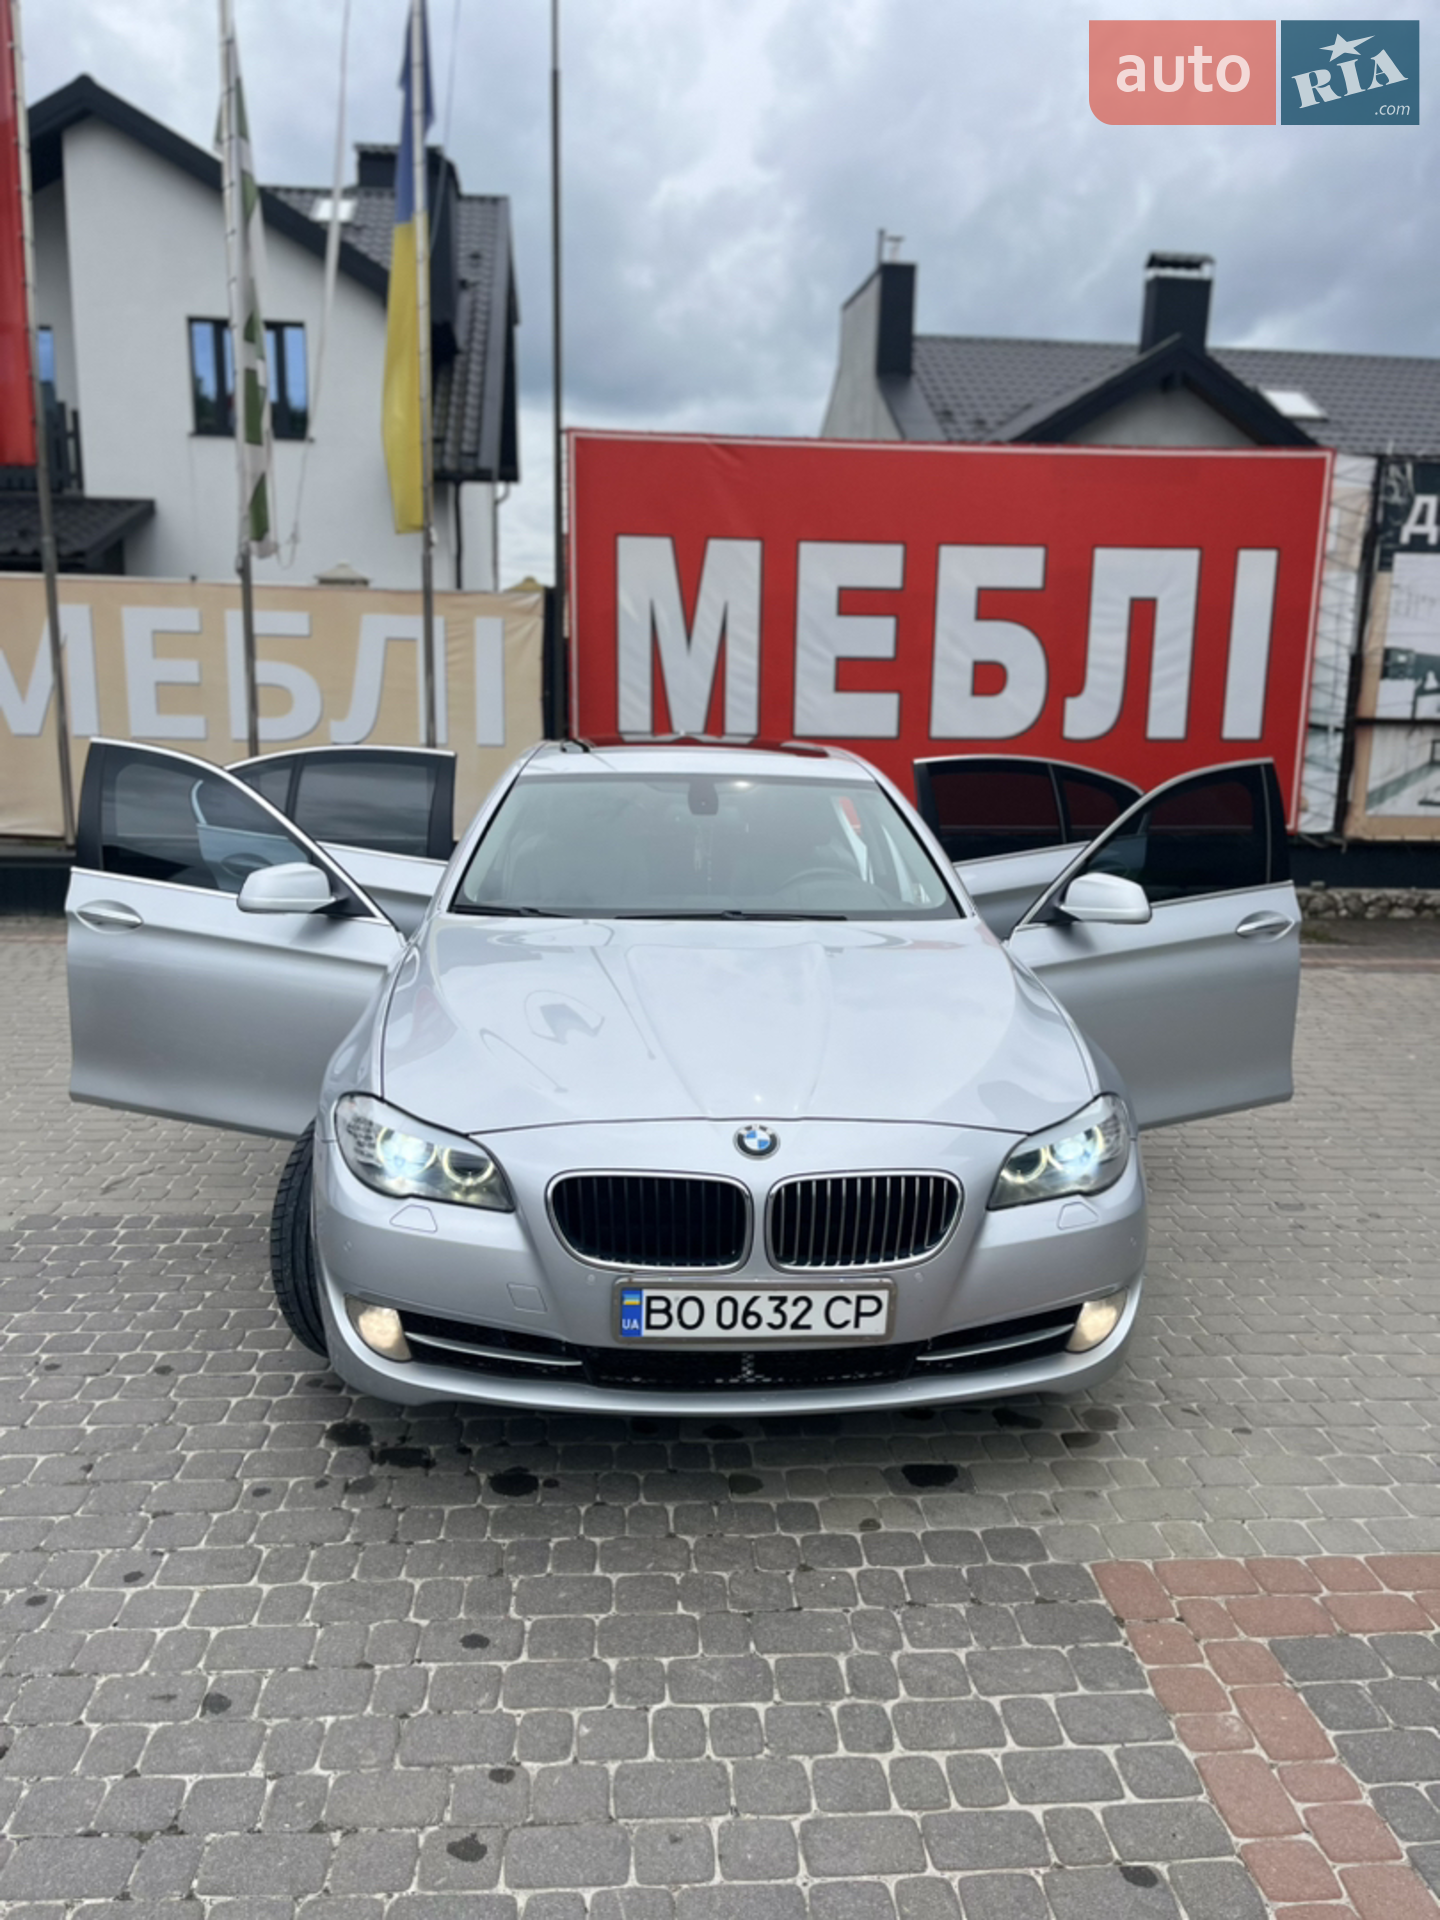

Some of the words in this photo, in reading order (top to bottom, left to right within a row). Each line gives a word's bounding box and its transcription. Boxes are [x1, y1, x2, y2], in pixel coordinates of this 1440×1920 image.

[615, 533, 1280, 743] МЕБЛІ
[621, 1318, 640, 1330] UA
[644, 1295, 705, 1331] BO
[715, 1295, 813, 1331] 0632
[823, 1294, 883, 1330] CP
